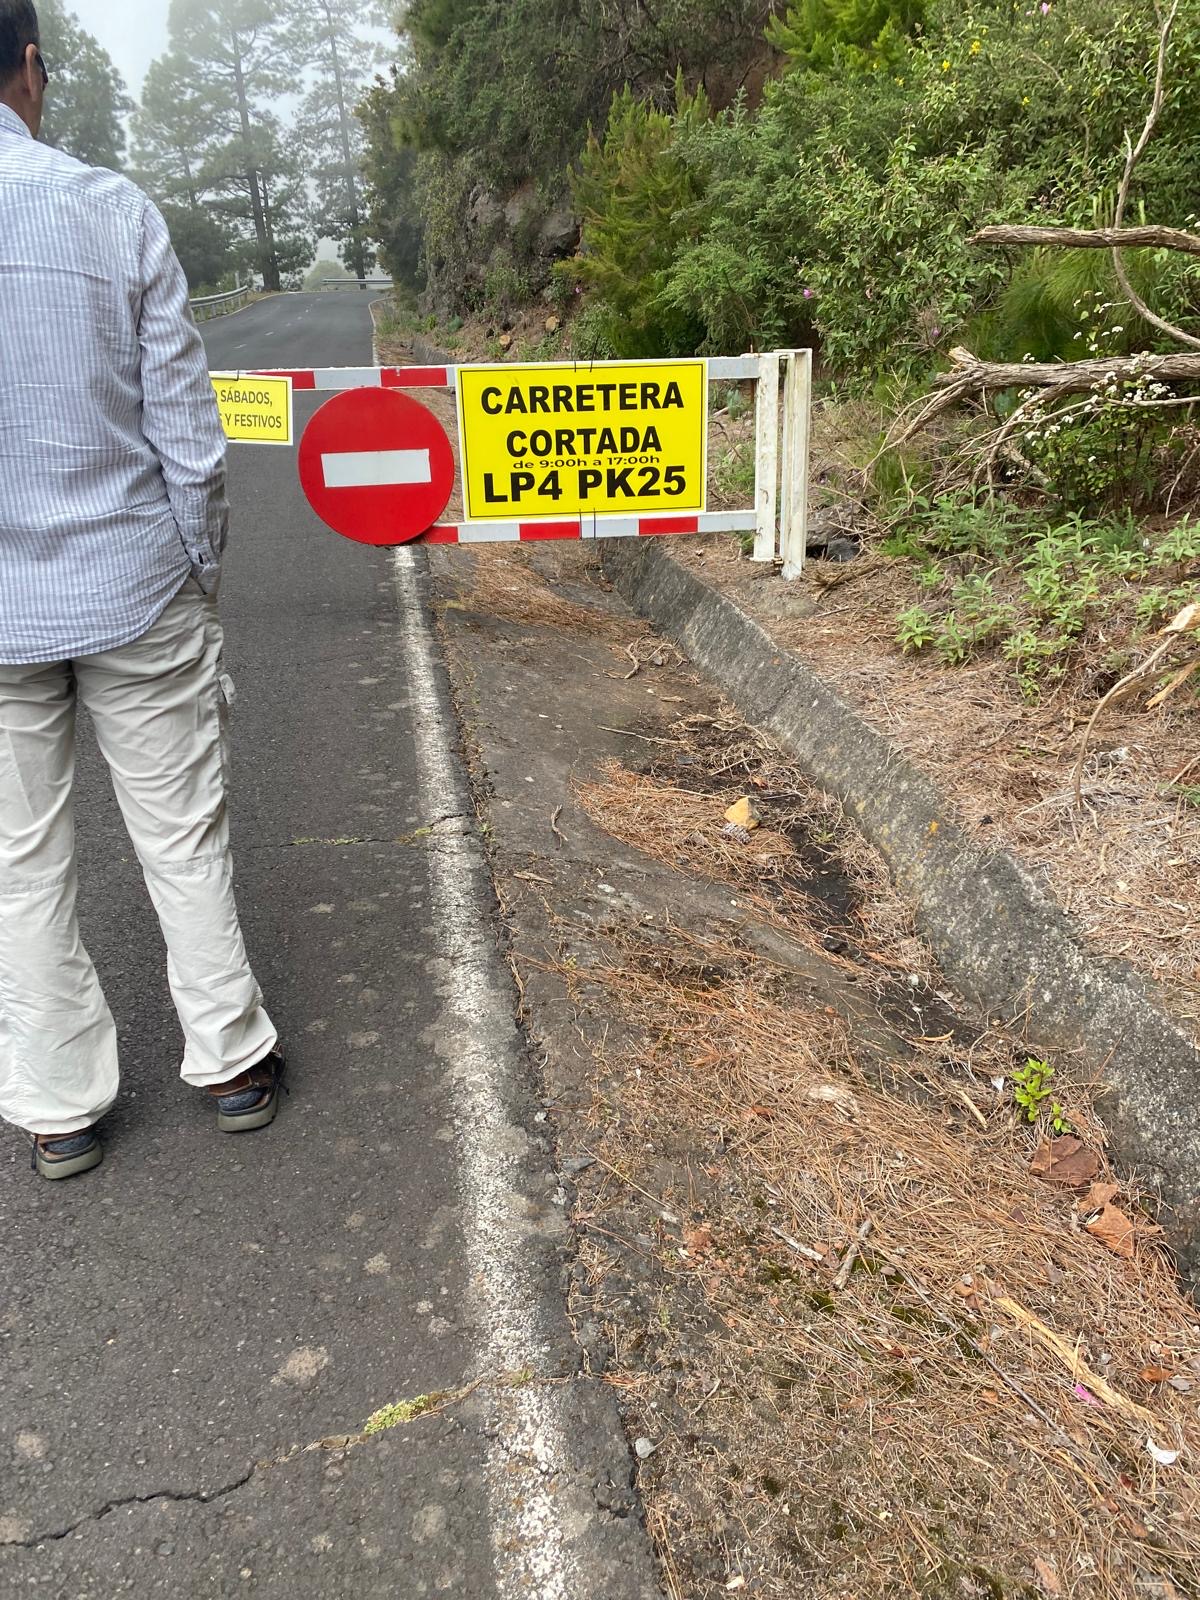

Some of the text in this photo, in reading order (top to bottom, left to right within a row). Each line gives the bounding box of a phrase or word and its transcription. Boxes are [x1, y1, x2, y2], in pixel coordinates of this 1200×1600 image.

[220, 387, 273, 407] SÁBADOS,
[481, 381, 685, 415] CARRETERA
[224, 413, 282, 429] Y FESTIVOS
[506, 426, 662, 457] CORTADA
[513, 460, 534, 469] de
[540, 457, 587, 467] 9:00h
[608, 456, 660, 466] 17:00h
[483, 465, 686, 503] LP4 PK25
